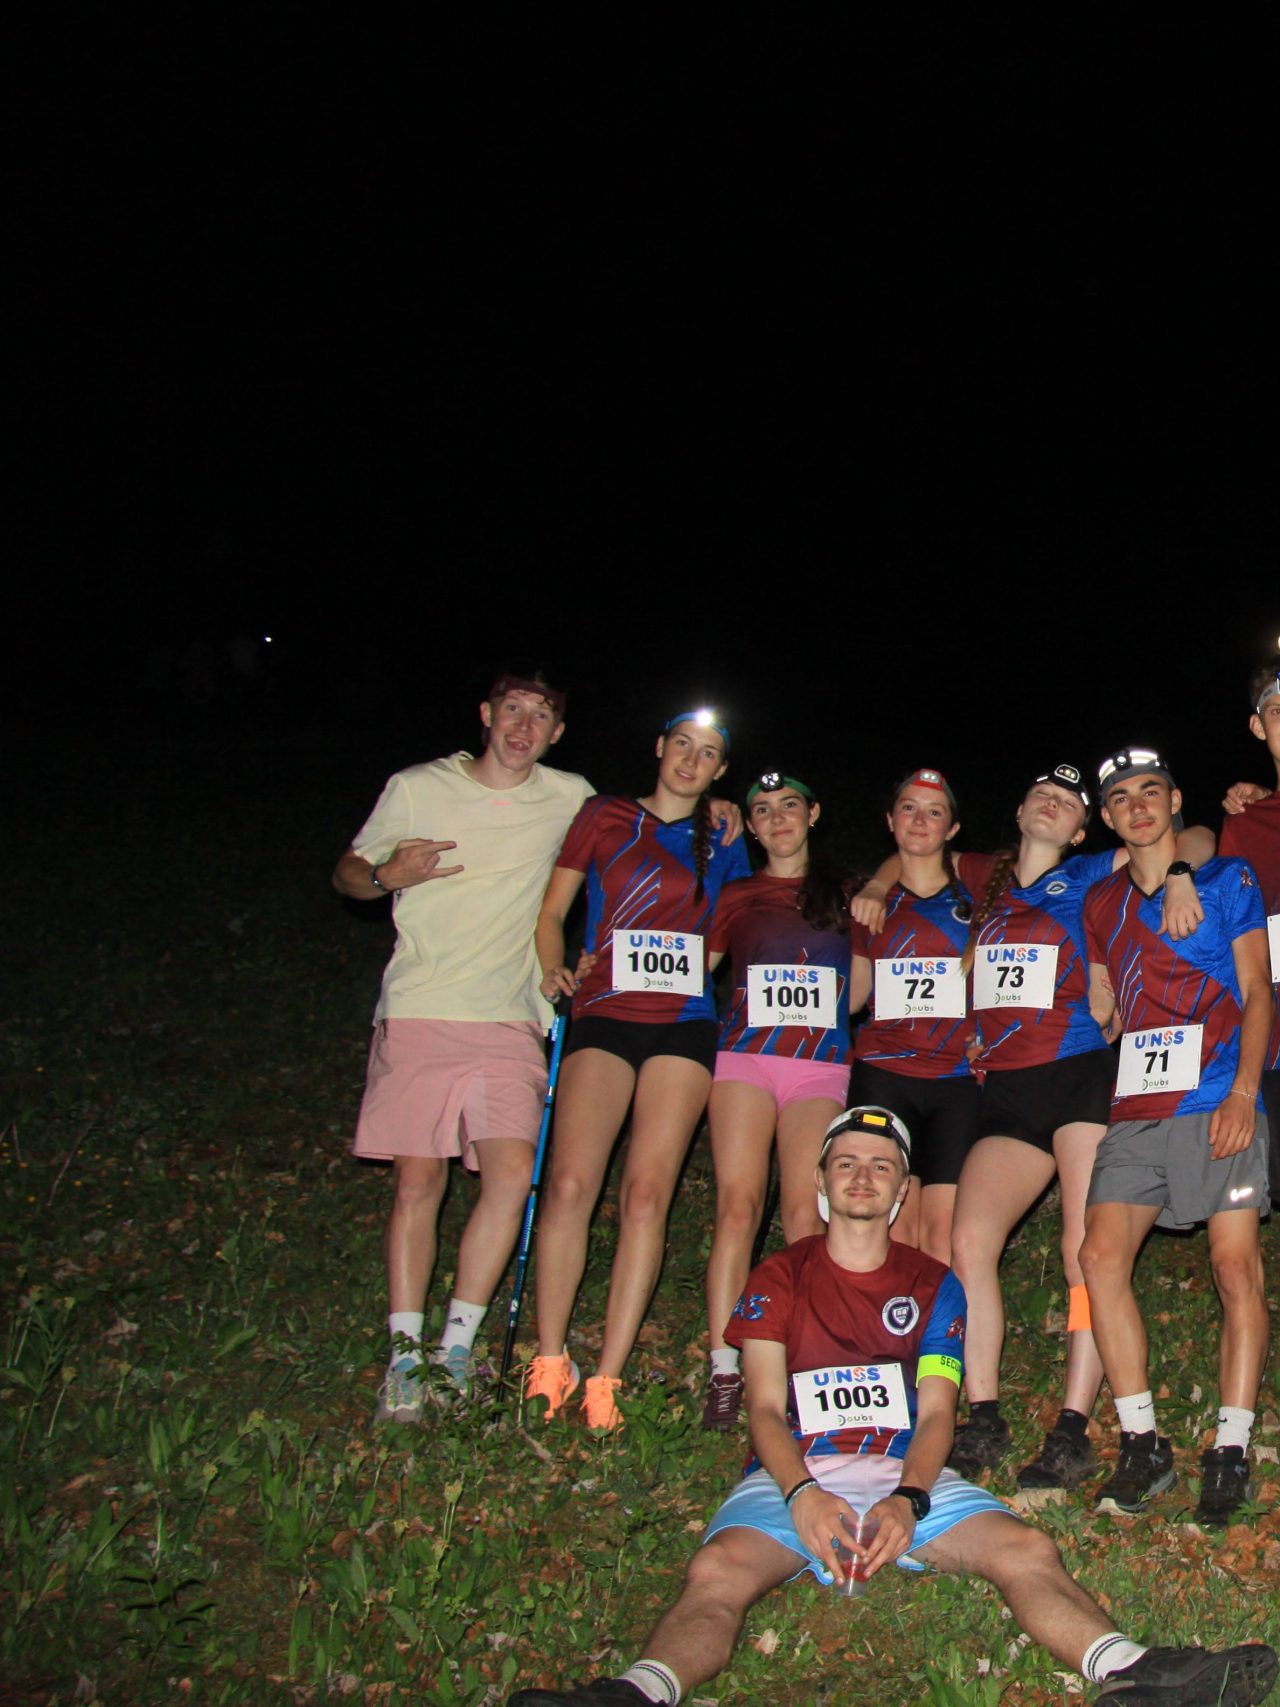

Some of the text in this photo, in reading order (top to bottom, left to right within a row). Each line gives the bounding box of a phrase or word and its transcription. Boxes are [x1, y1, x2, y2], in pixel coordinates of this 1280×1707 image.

[630, 934, 687, 950] UNSS
[628, 951, 690, 976] 1004
[987, 946, 1039, 963] UNSS
[764, 968, 819, 984] UNSS
[891, 960, 947, 976] UNSS
[996, 965, 1025, 988] 73
[762, 986, 820, 1009] 1001
[904, 978, 935, 1000] 72
[1134, 1030, 1185, 1049] UNSS
[1144, 1049, 1169, 1074] 71
[813, 1366, 881, 1387] UNSS
[814, 1384, 890, 1412] 1003
